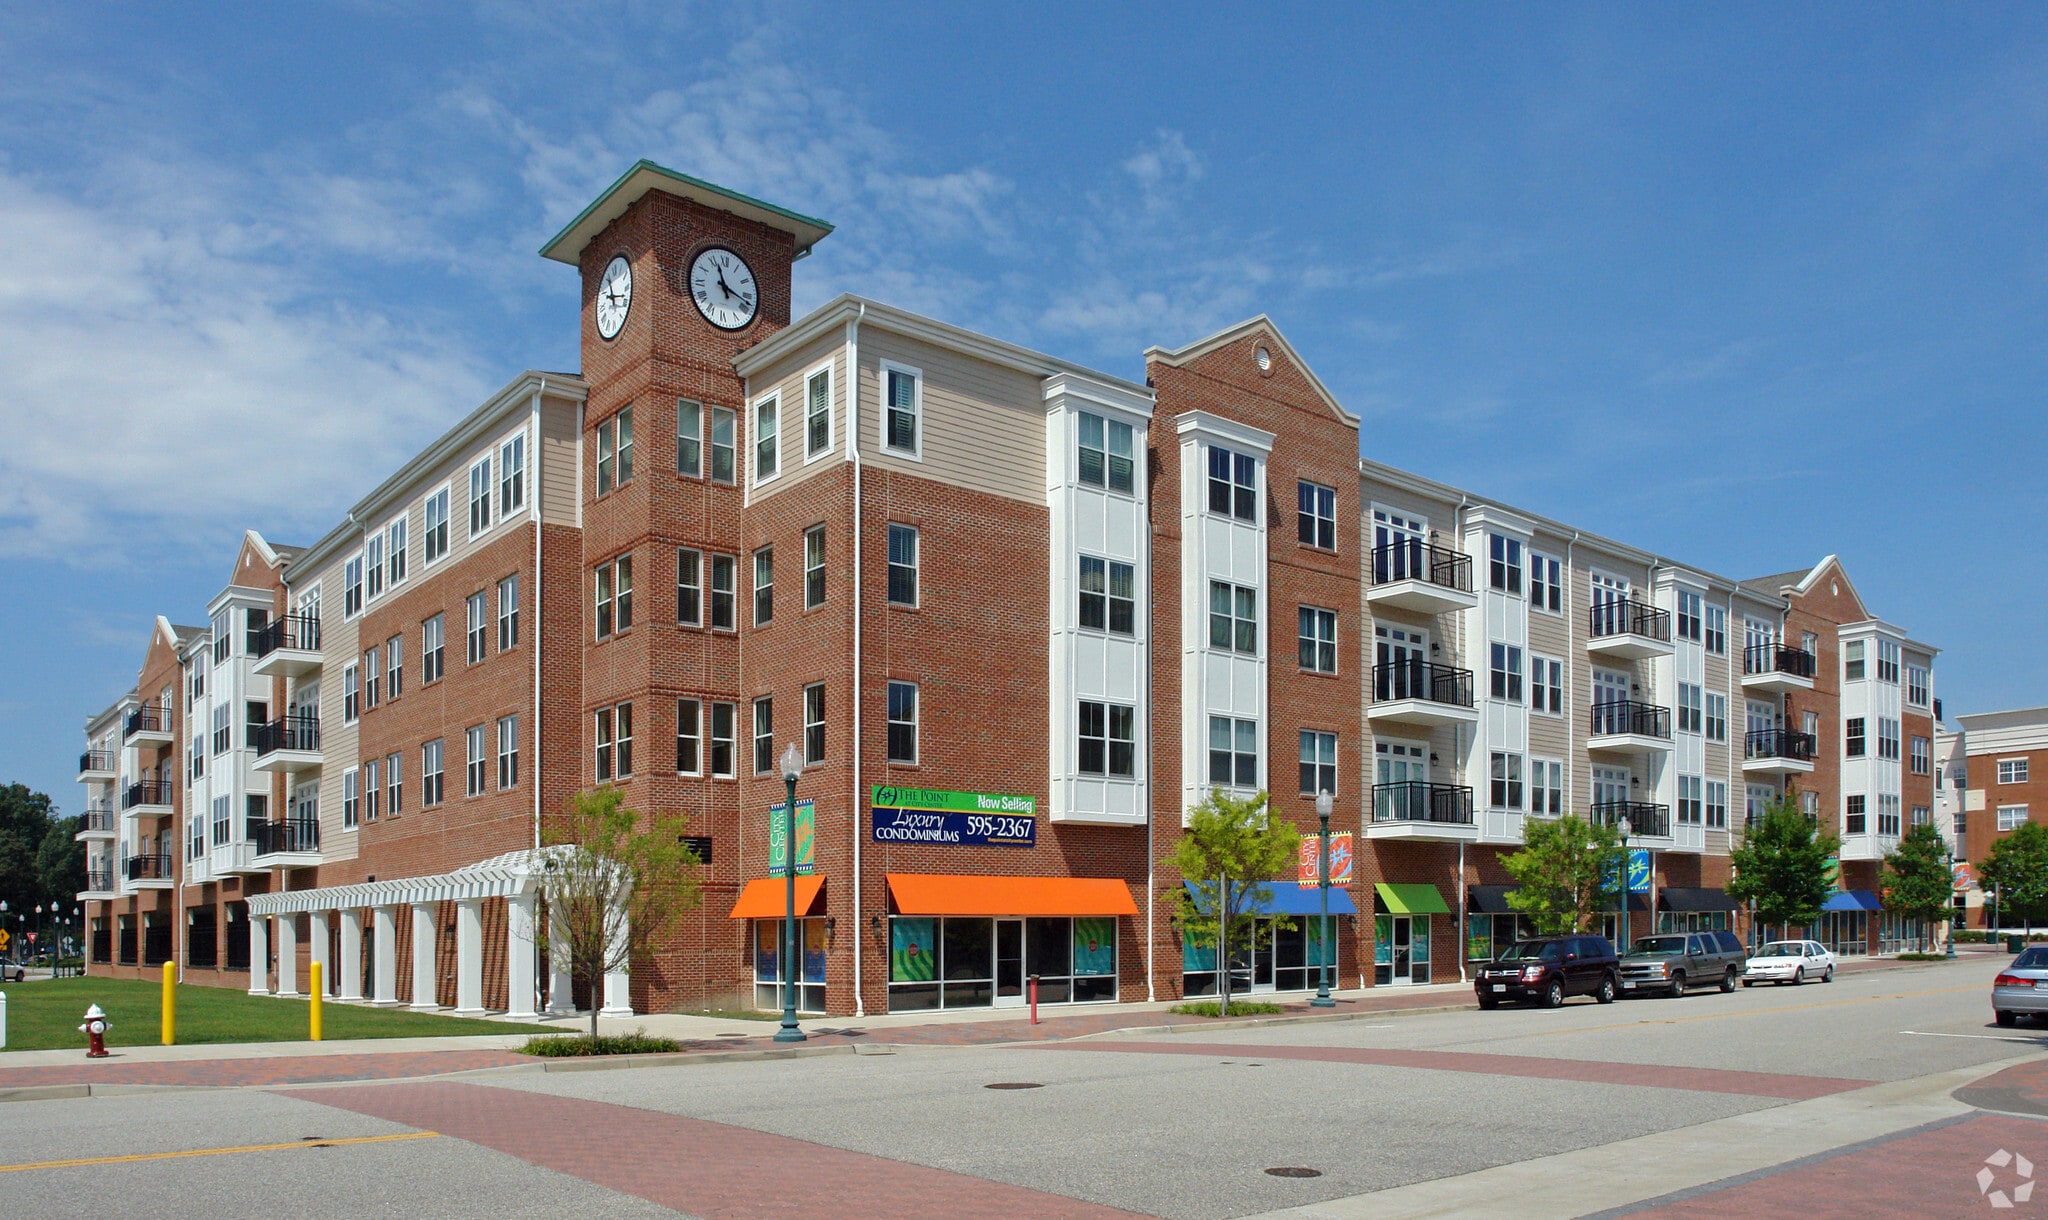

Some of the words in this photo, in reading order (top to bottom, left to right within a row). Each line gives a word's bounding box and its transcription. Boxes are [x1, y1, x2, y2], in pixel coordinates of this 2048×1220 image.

[898, 788, 917, 801] THE
[921, 790, 950, 803] POINT
[977, 794, 1000, 809] Now
[1001, 796, 1033, 814] Selling
[770, 814, 780, 847] CITY
[892, 807, 944, 834] Luxury
[966, 816, 1033, 838] 595-2367
[876, 826, 960, 843] CONDOMINIUMS
[1300, 841, 1310, 866] CITY
[1305, 838, 1316, 877] CENTER
